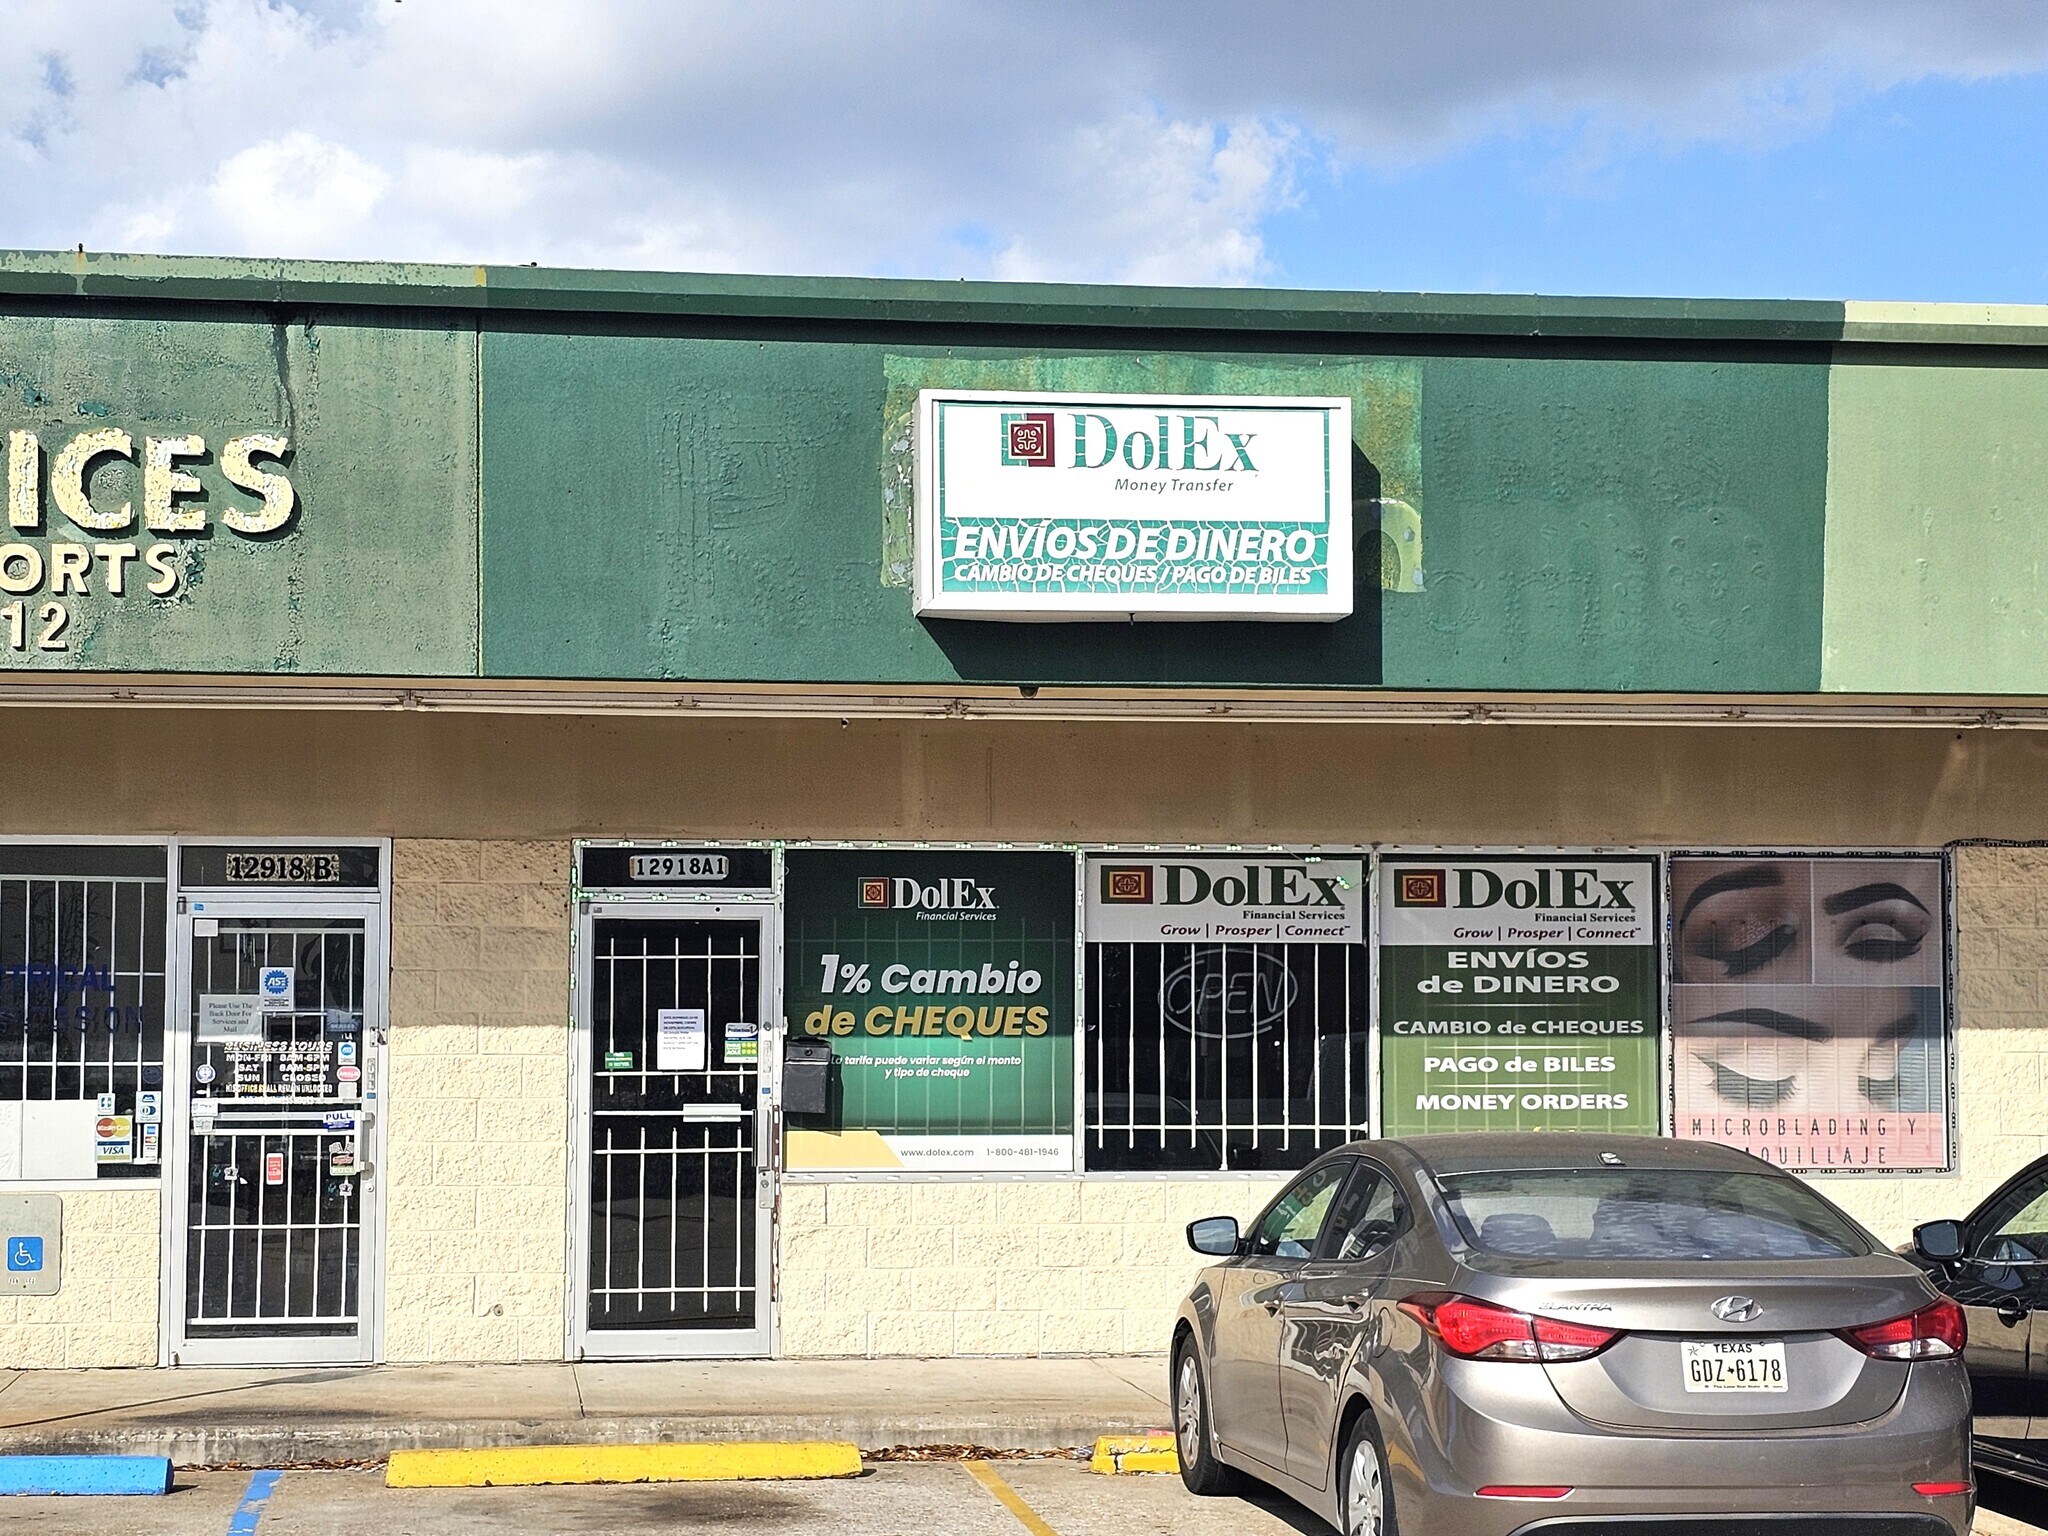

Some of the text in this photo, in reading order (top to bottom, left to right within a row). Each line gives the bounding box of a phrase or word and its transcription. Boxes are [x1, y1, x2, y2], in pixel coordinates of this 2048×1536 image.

[1068, 412, 1260, 472] DolEx
[1114, 477, 1234, 494] Money Transfer
[955, 519, 1317, 562] ENVÍOS DE DINERO
[0, 543, 181, 594] ORTS
[954, 564, 1037, 583] CAMBIO
[1036, 565, 1065, 582] DE
[1066, 565, 1158, 584] CHEQUES
[1172, 565, 1225, 584] PAGO
[1228, 566, 1257, 584] DE
[1258, 566, 1311, 585] BILES
[1, 601, 70, 649] 12
[230, 856, 332, 880] 12918 B
[636, 857, 725, 876] 12918A1
[891, 876, 997, 910] DolEx
[1159, 864, 1346, 908] DolEx
[1451, 868, 1637, 910] DolEx
[916, 911, 997, 921] Financial Services
[1242, 909, 1346, 920] Financial Services
[1534, 912, 1636, 923] Financial Services
[1160, 924, 1201, 936] Grow
[1214, 924, 1272, 940] Prosper
[1453, 927, 1493, 939] Grow
[1507, 926, 1564, 942] Prosper
[1447, 947, 1590, 969] ENVÍOS
[0, 963, 118, 993] TRICAL
[820, 954, 1043, 995] 1% Cambio
[1167, 972, 1285, 1015] OPEN
[1416, 975, 1620, 994] de DINERO
[804, 1004, 1050, 1041] de CHEQUES
[1393, 1020, 1644, 1035] CAMBIO de CHEQUES
[844, 1055, 873, 1065] tarifa
[874, 1055, 908, 1068] puede
[910, 1055, 940, 1065] variar
[941, 1055, 974, 1068] según
[975, 1055, 986, 1065] el
[987, 1056, 1022, 1065] monto
[1424, 1056, 1616, 1073] PAGO de BILES
[885, 1067, 971, 1079] y tipo de cheque
[1415, 1094, 1629, 1111] MONEY ORDERS
[325, 1112, 353, 1121] PULL
[1691, 1118, 1917, 1137] MICROBLADING Y
[102, 1146, 125, 1155] VISA
[900, 1147, 1060, 1157] www.dolex.com 1-800-481-1946
[1713, 1343, 1753, 1354] TEXAS
